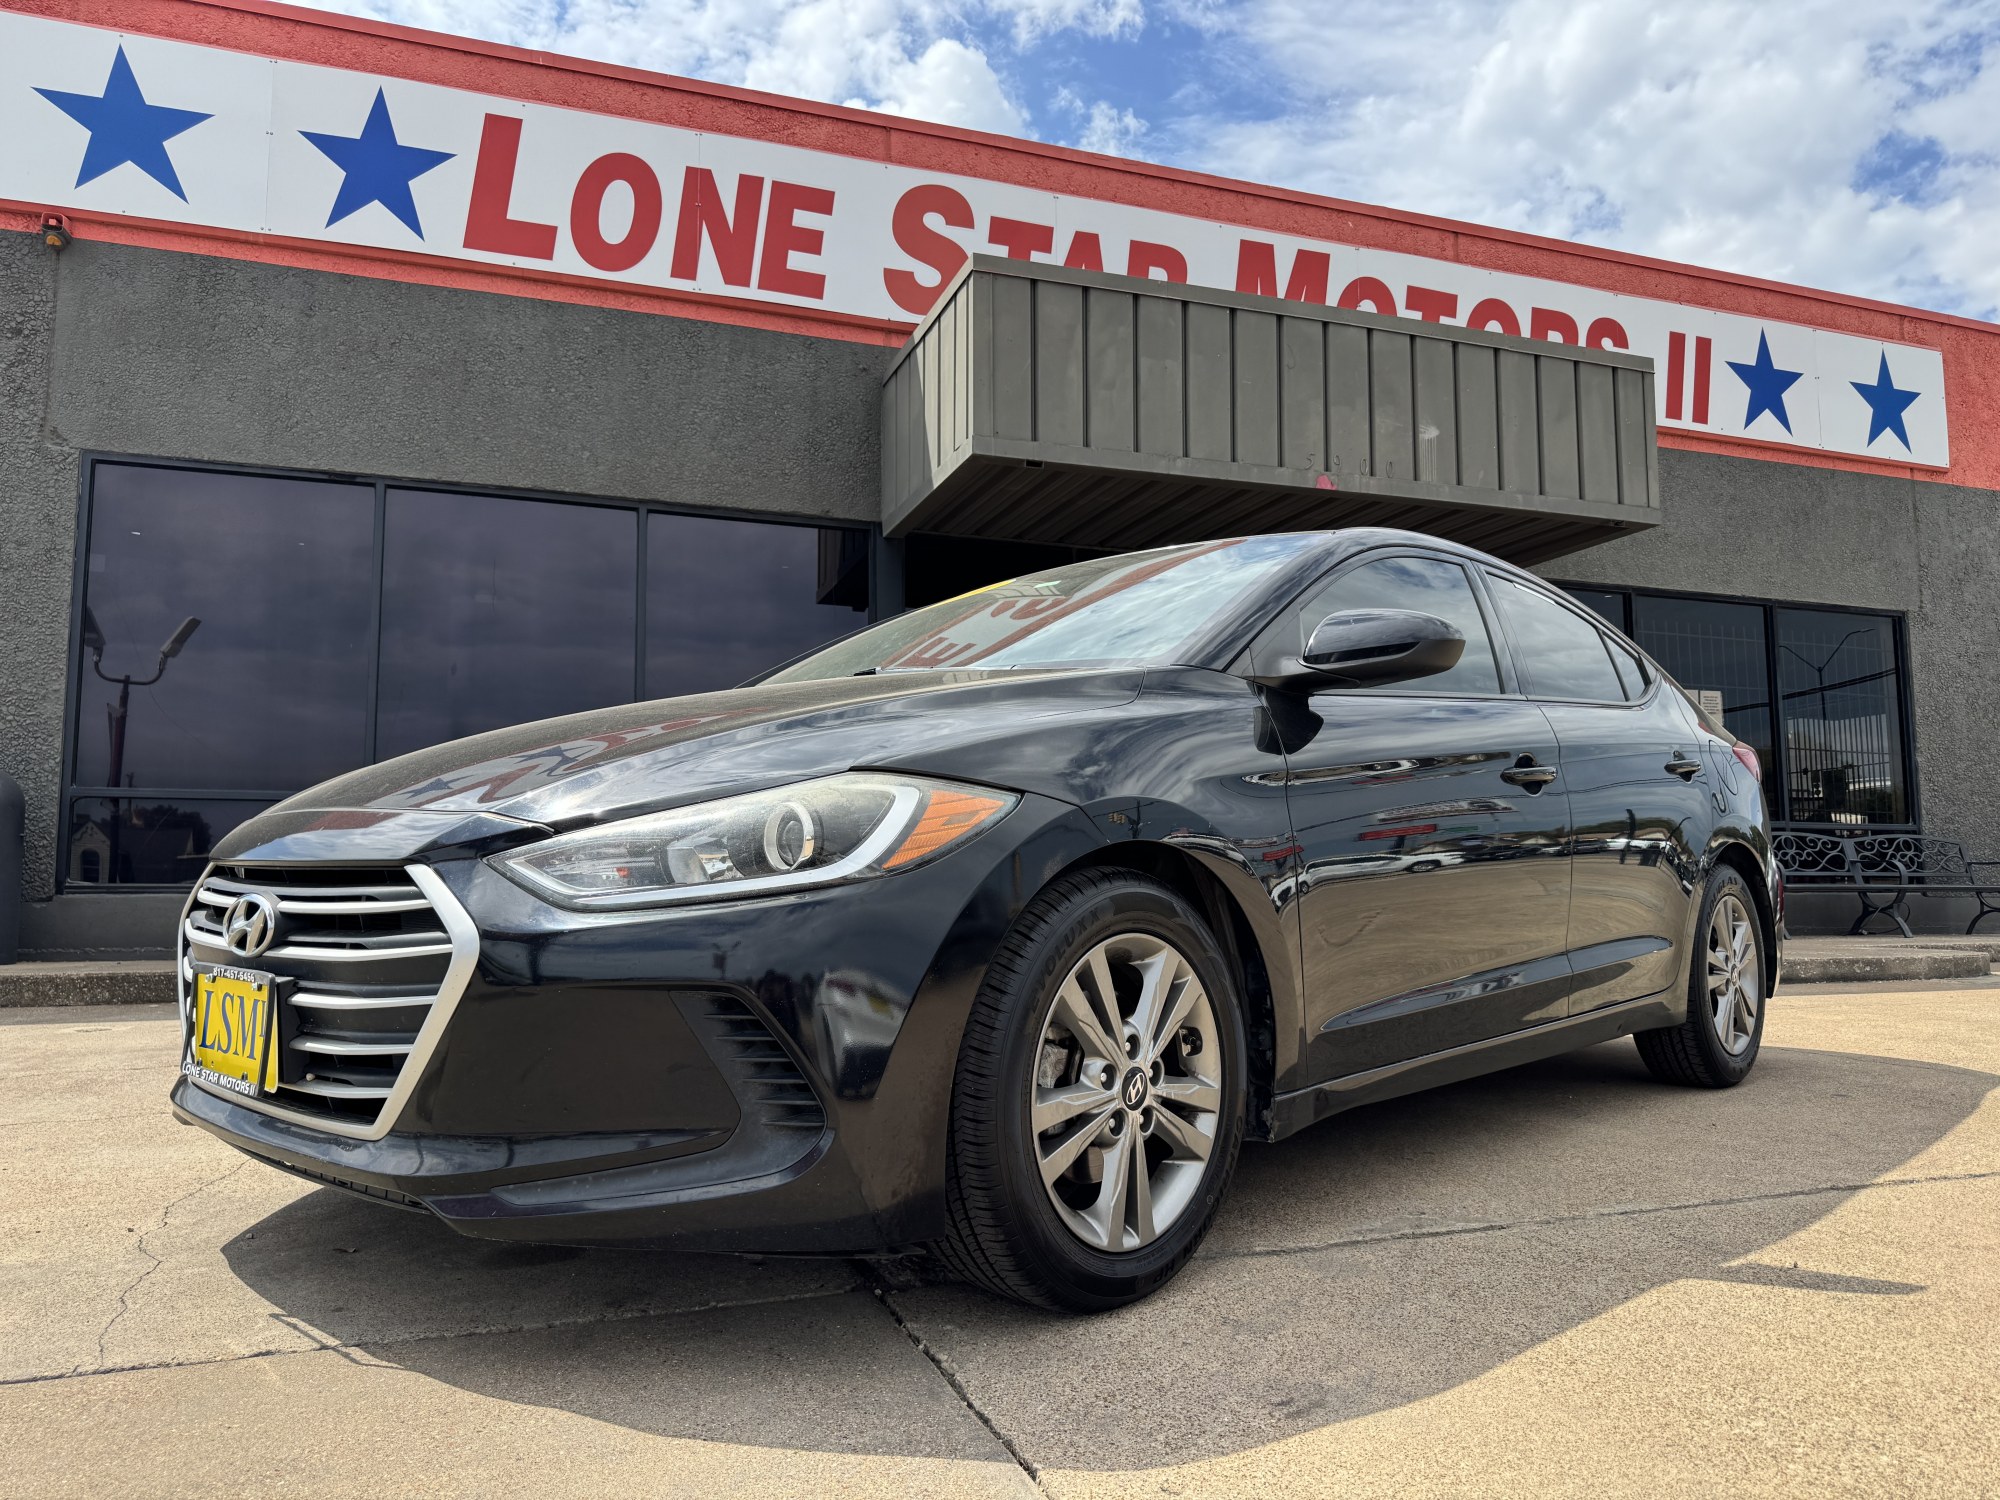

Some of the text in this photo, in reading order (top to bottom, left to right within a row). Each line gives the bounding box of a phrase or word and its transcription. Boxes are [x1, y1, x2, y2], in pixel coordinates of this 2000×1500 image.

[463, 112, 836, 300] LONE
[1666, 331, 1712, 425] II
[213, 967, 255, 983] 817-457-5456
[1028, 907, 1100, 1014] EVOLUXX
[182, 1061, 201, 1078] LONE
[201, 1069, 219, 1084] STAR
[219, 1074, 250, 1094] MOTORS
